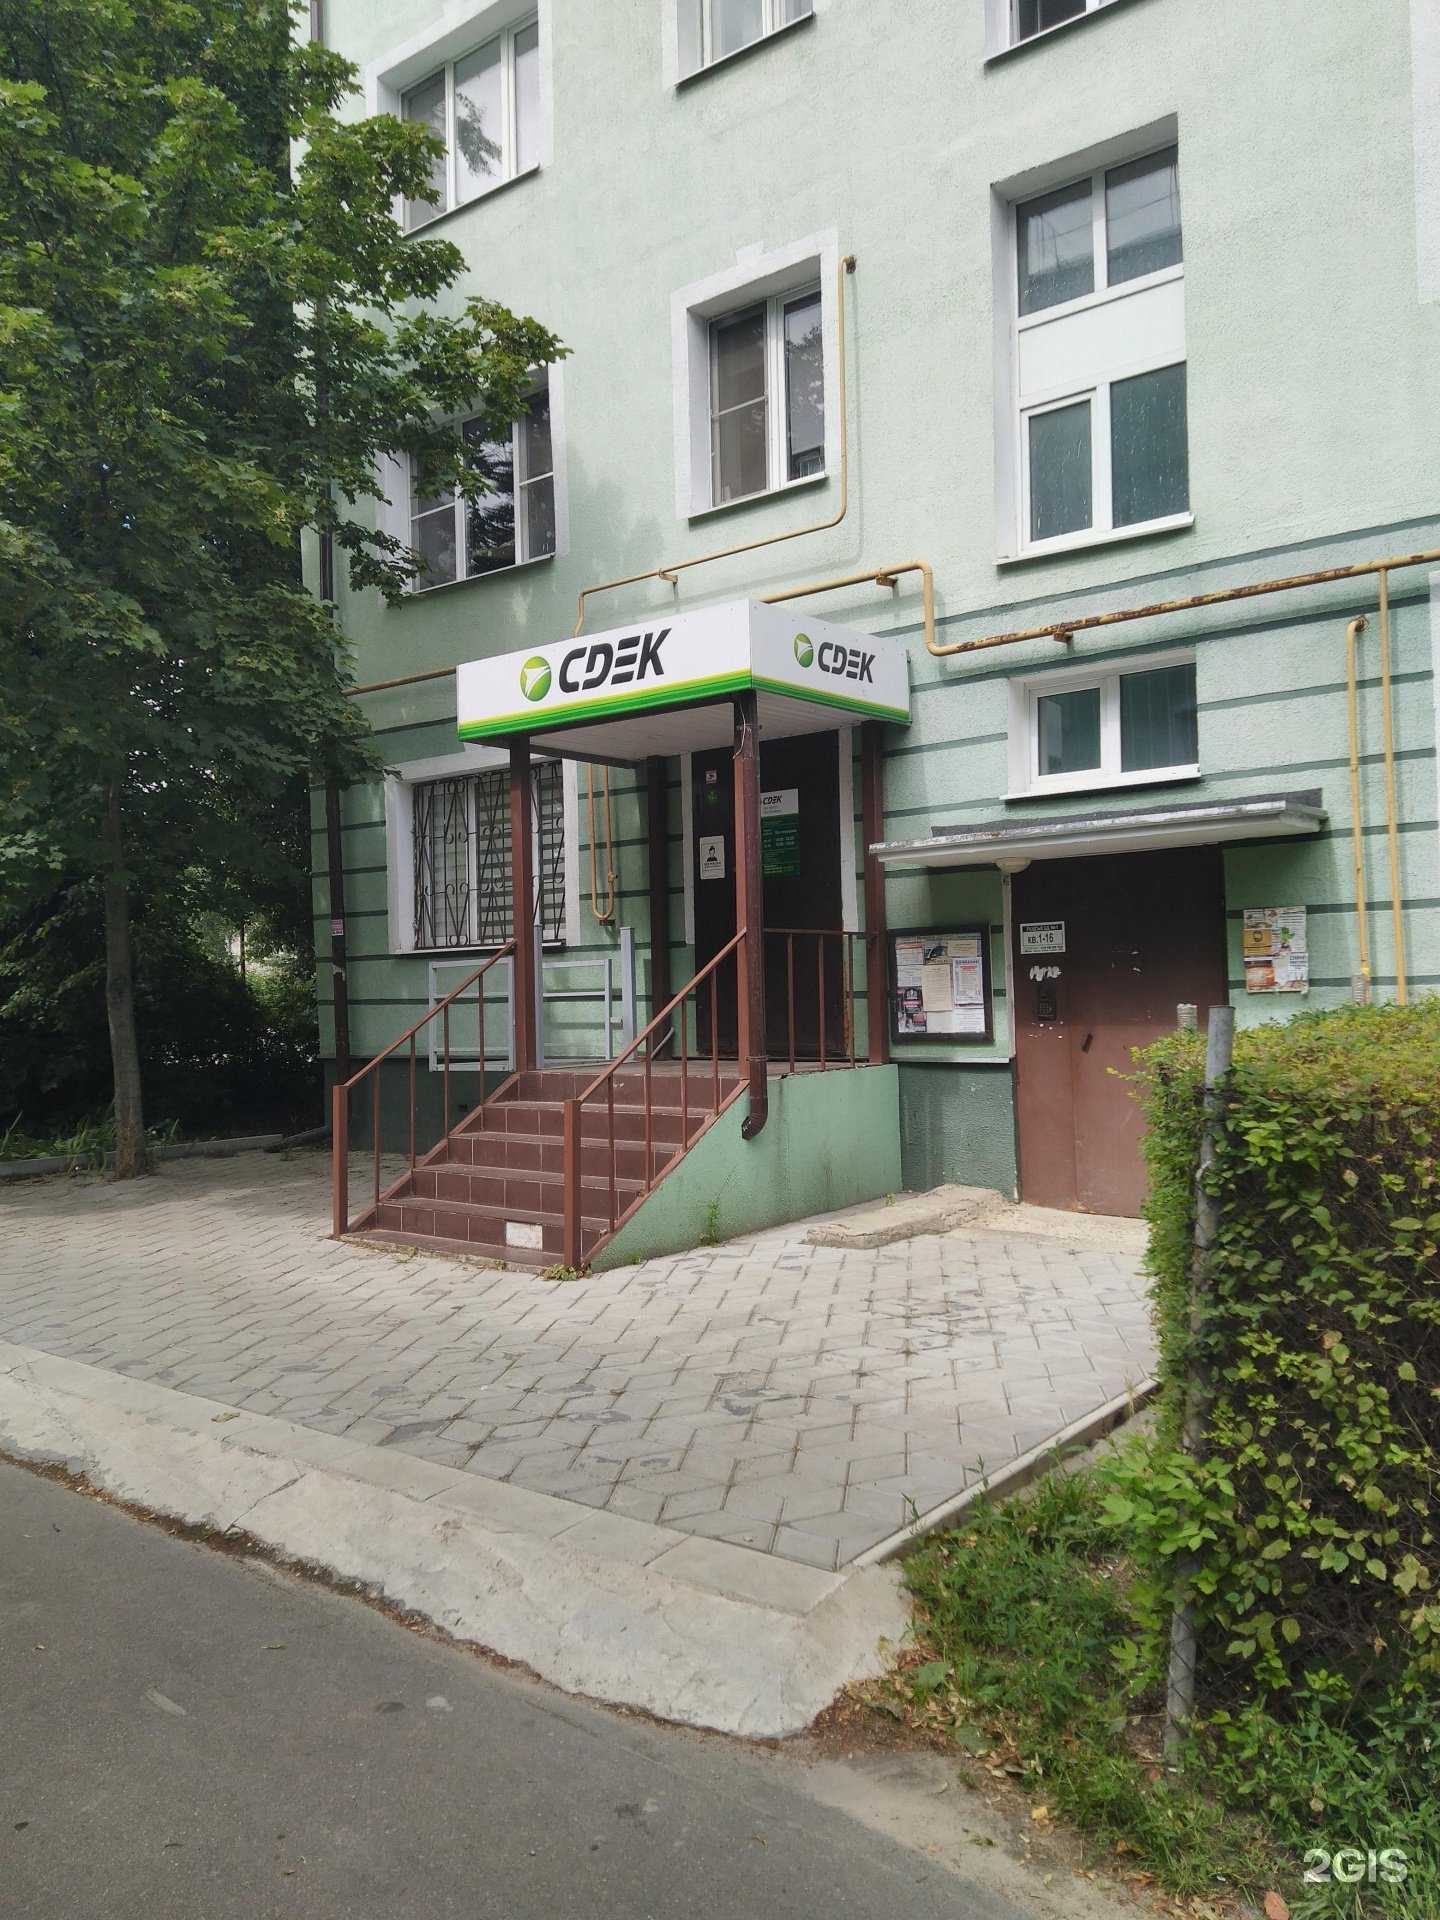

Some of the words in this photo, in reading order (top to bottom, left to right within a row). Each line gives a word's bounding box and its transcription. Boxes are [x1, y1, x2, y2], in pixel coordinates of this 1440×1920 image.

[558, 628, 672, 694] CDEK
[817, 641, 877, 684] CDEK
[762, 795, 782, 805] CDEK
